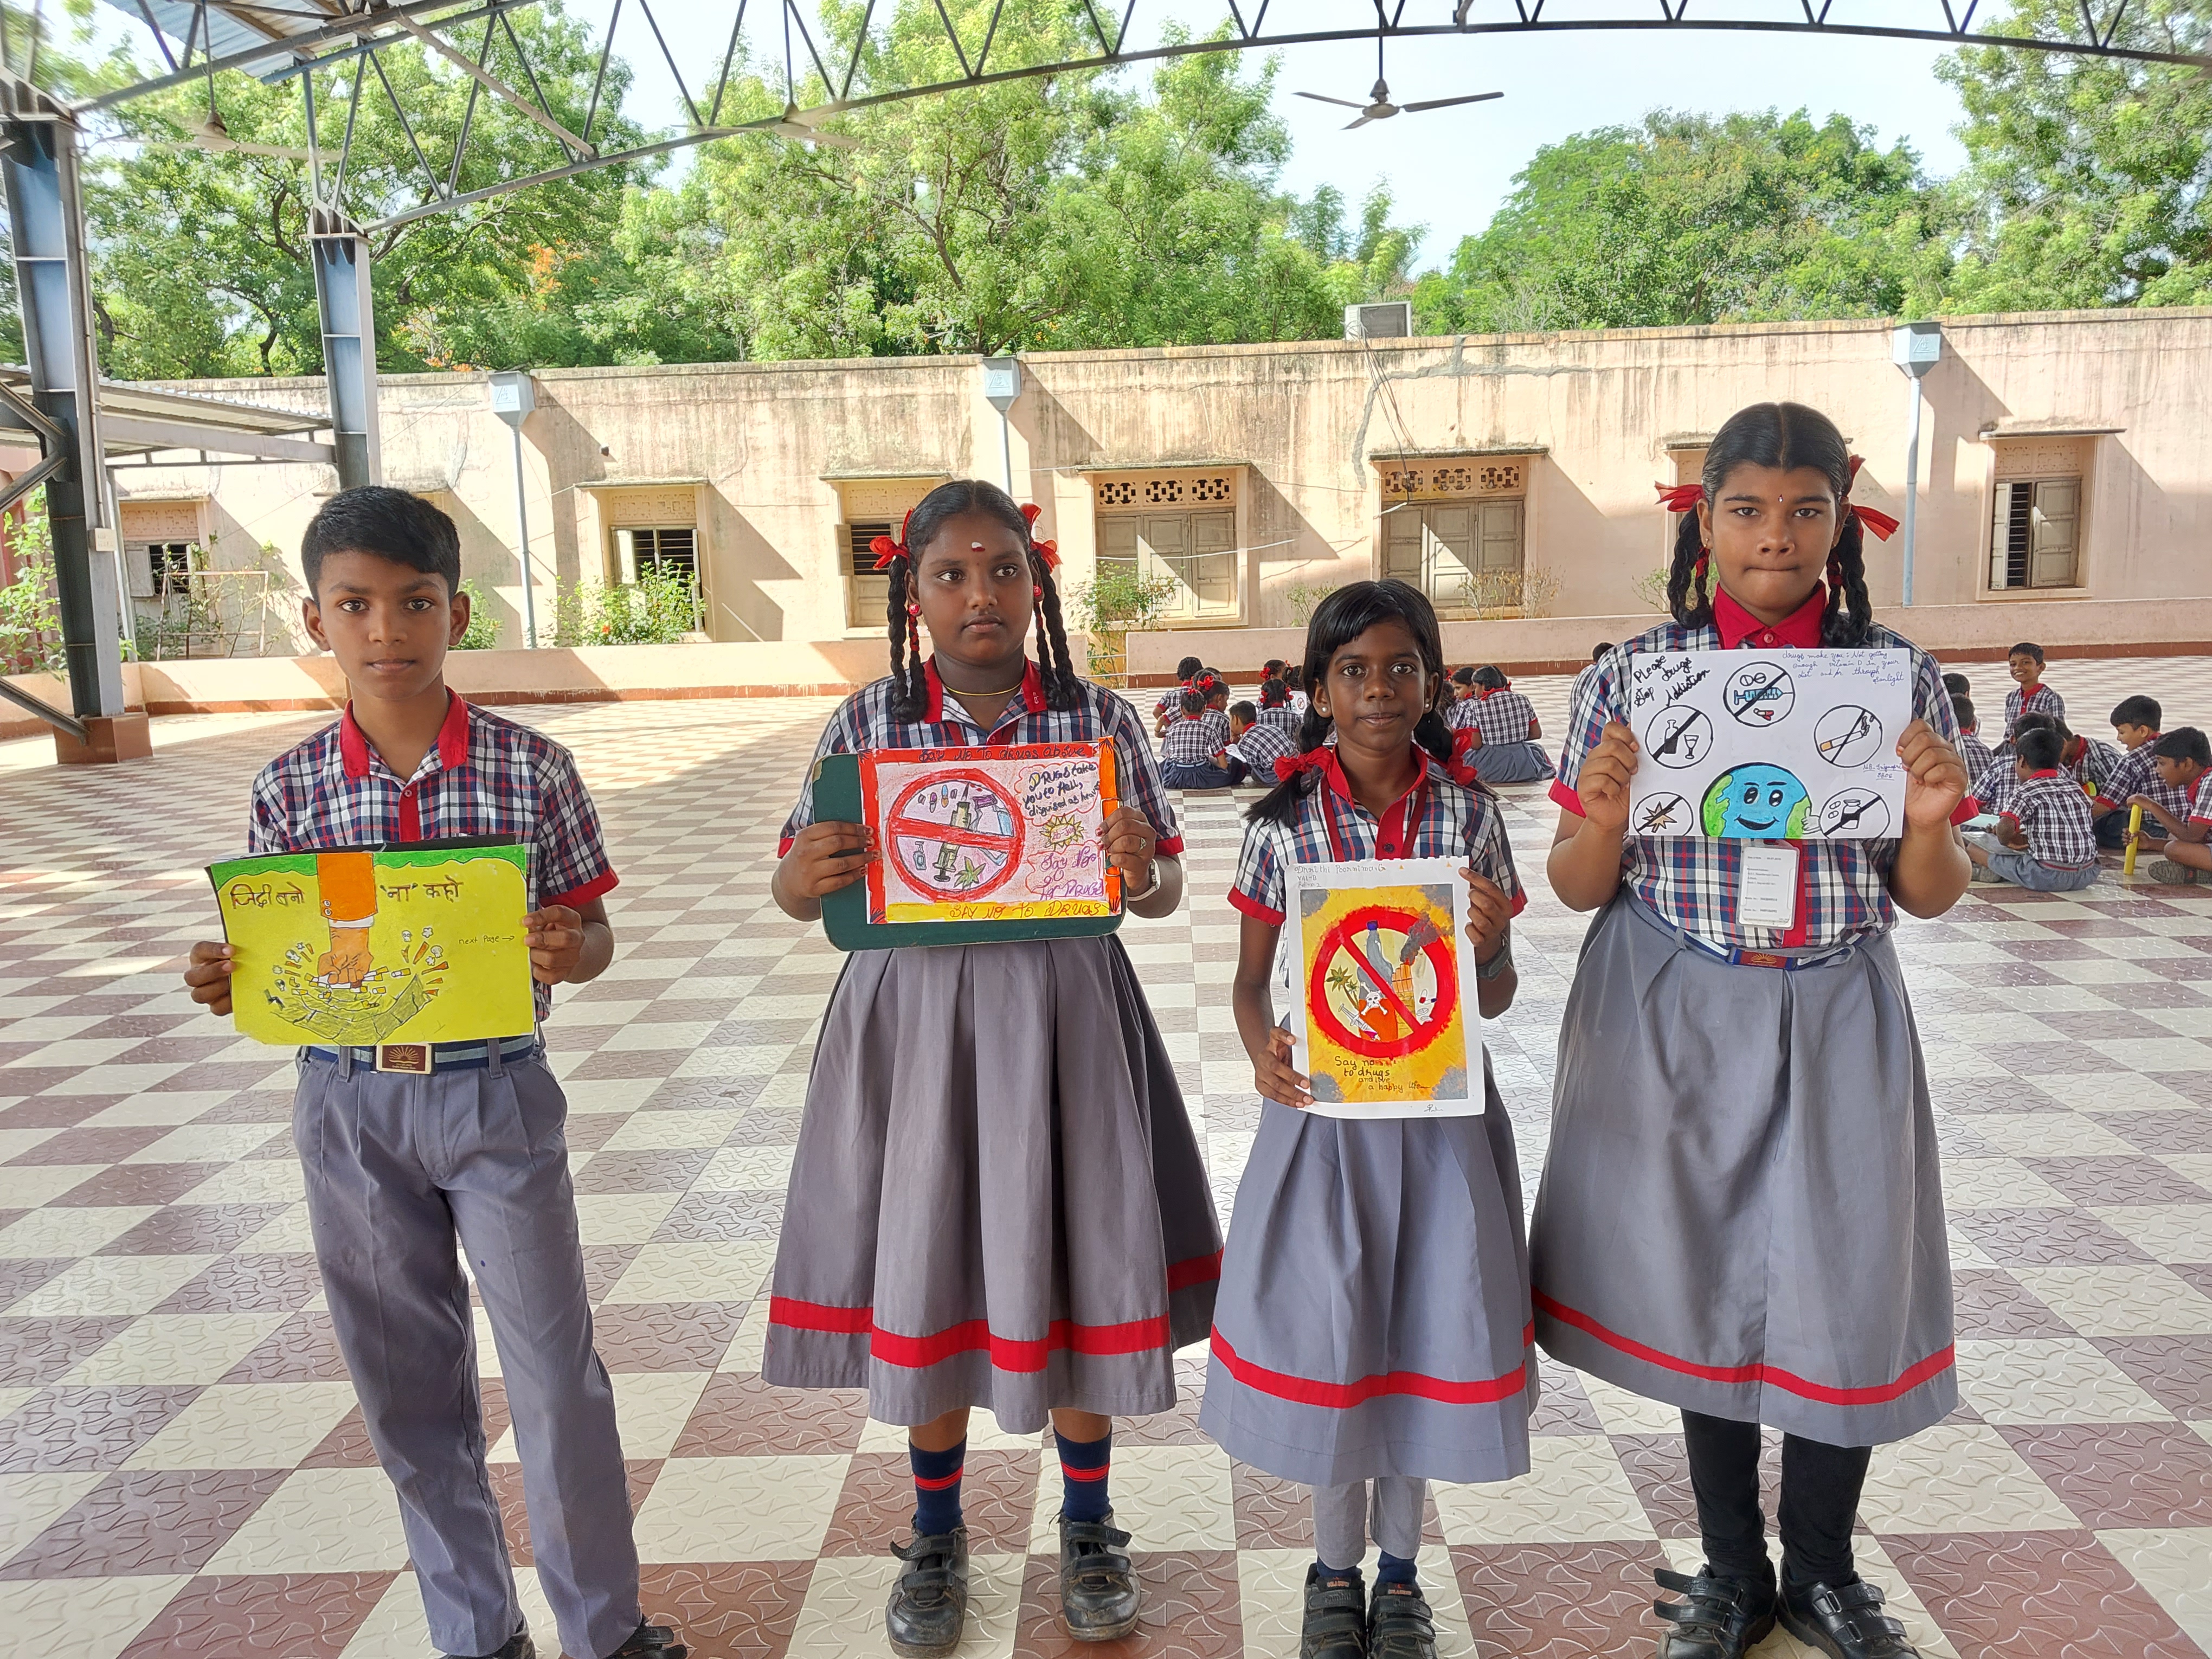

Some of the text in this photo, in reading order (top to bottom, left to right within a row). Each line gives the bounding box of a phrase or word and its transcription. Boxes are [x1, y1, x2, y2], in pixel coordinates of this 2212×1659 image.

[1881, 659, 1900, 670] your
[1071, 763, 1097, 776] take
[1068, 795, 1079, 805] as
[275, 881, 305, 907] बनो
[422, 874, 464, 903] कहो
[459, 935, 499, 945] next Page
[1334, 1056, 1357, 1070] Say
[1343, 1066, 1391, 1081] to drugs
[1379, 1083, 1403, 1093] happy
